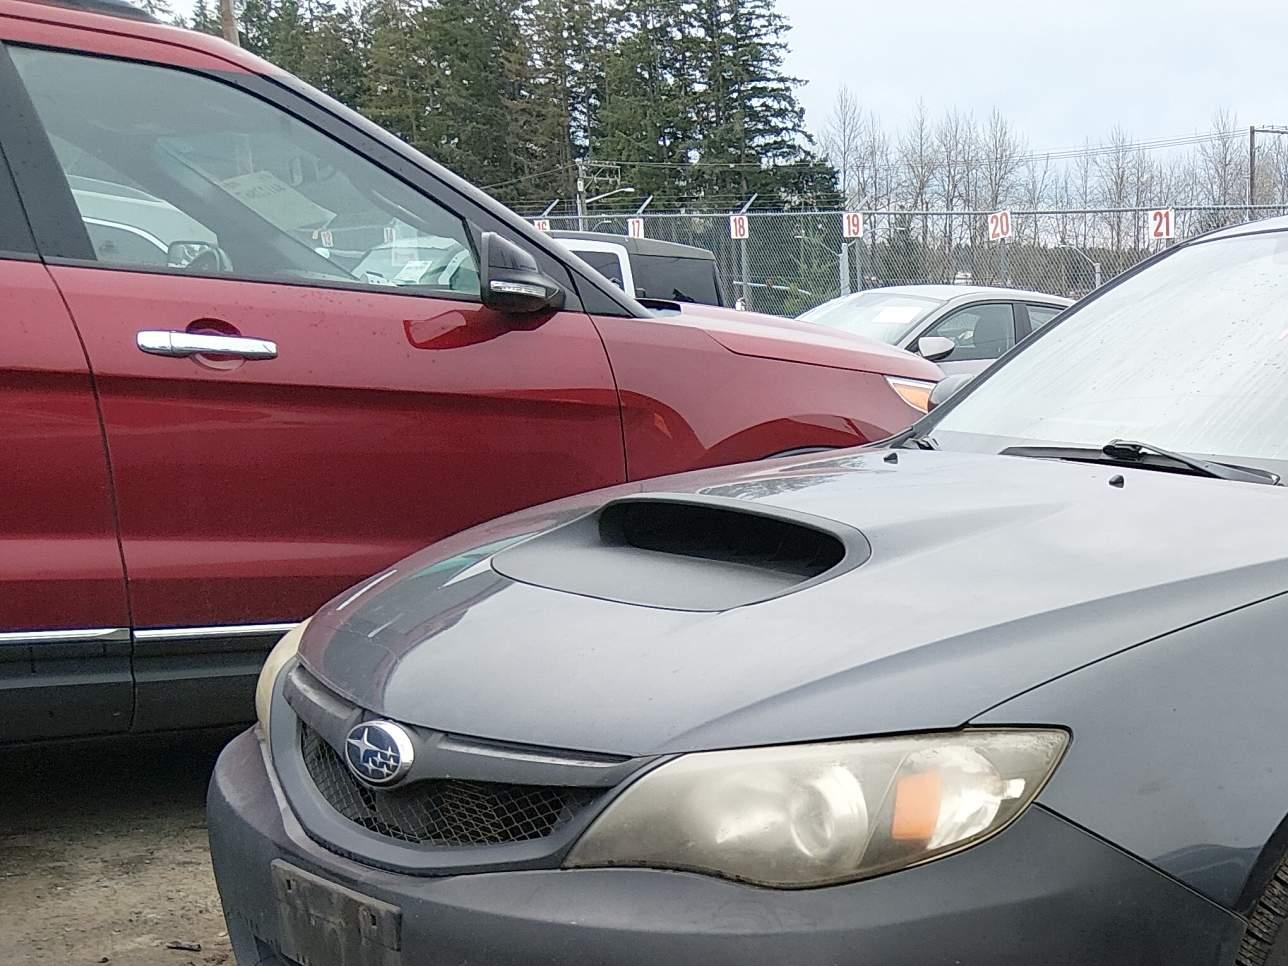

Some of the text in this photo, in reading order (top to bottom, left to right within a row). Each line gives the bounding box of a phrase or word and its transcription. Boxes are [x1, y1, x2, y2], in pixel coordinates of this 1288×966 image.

[631, 219, 641, 238] 17
[733, 216, 746, 238] 18
[846, 213, 860, 236] 19
[990, 212, 1010, 239] 20
[1153, 211, 1170, 237] 21
